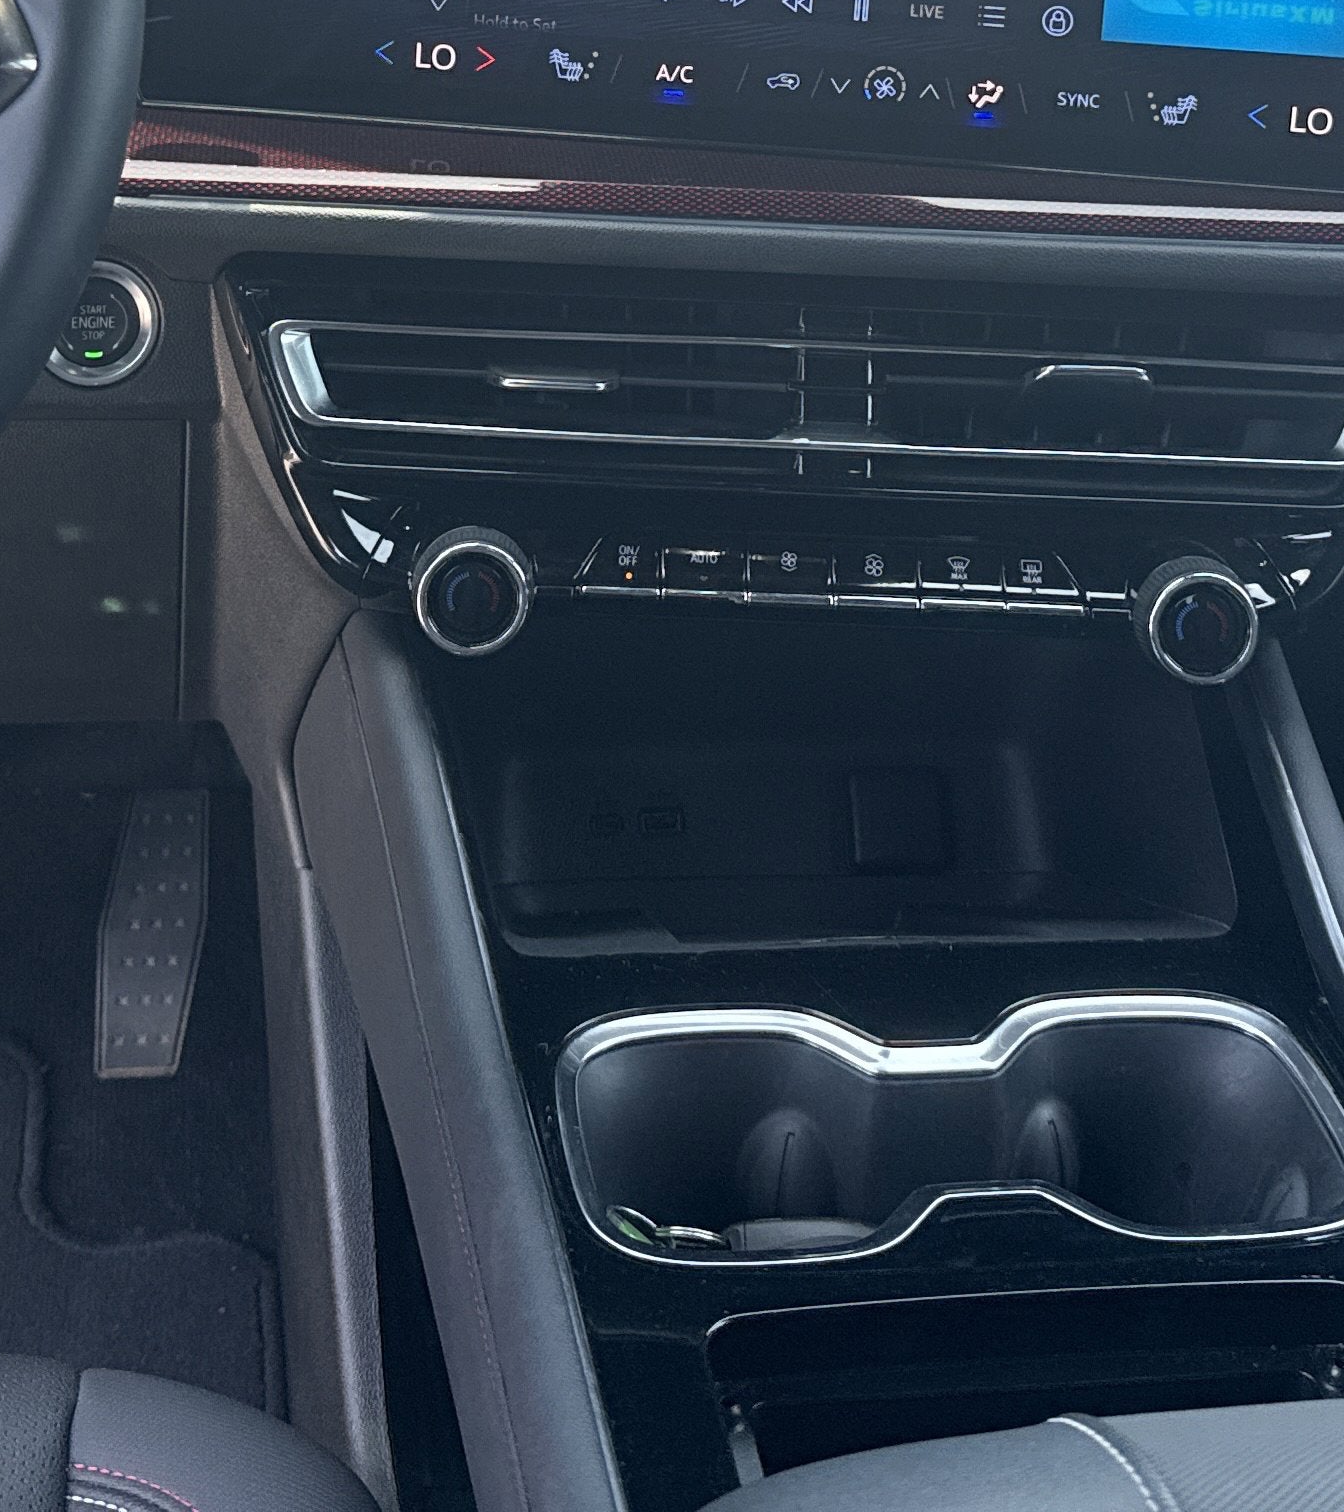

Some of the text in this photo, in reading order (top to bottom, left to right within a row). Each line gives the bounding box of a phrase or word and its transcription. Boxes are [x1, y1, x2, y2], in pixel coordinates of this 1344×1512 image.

[910, 4, 944, 20] LIVE
[415, 42, 456, 70] LO
[656, 64, 694, 84] A/C
[1057, 92, 1100, 109] SYNC
[1289, 106, 1334, 136] LO
[80, 305, 106, 315] START
[71, 316, 116, 329] ENGINE
[82, 331, 106, 340] STOP
[618, 545, 640, 555] ON/
[618, 556, 638, 566] OFF
[690, 552, 718, 564] AUTO
